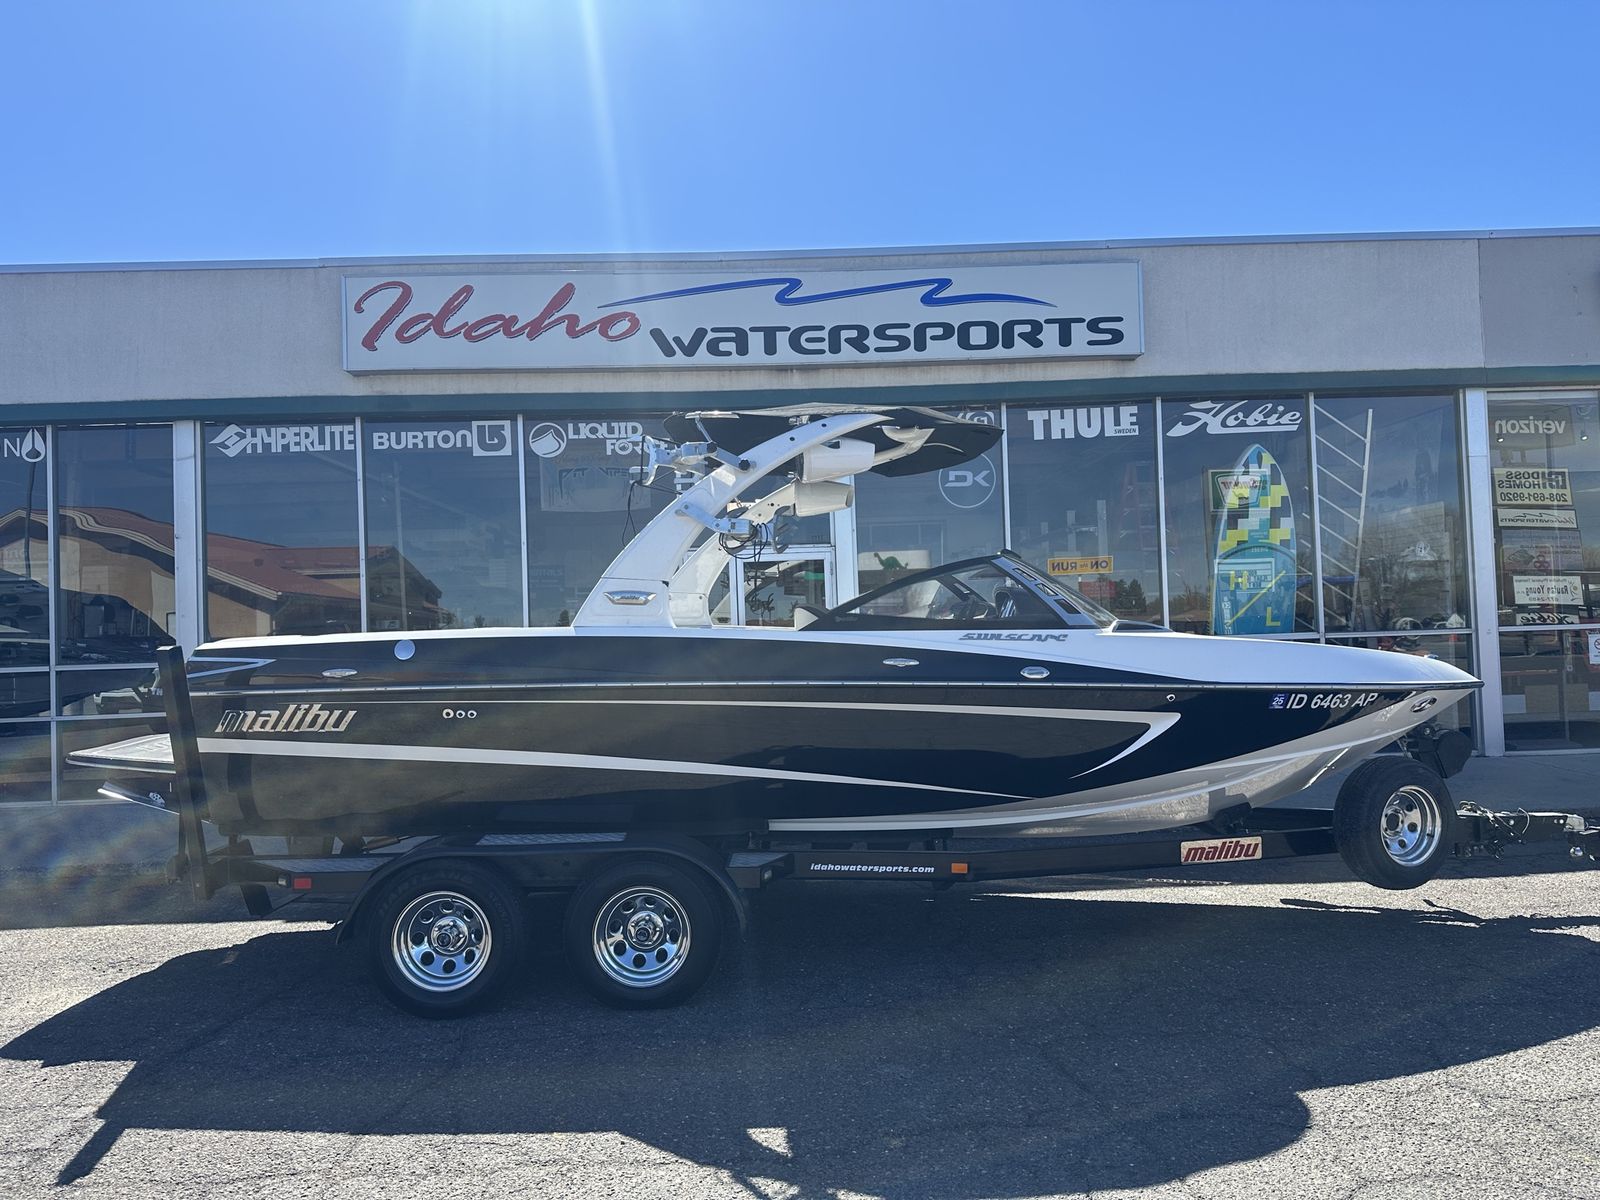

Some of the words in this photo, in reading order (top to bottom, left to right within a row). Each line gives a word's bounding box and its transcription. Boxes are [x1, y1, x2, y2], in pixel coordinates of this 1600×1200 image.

[353, 280, 641, 351] Idaho
[1027, 405, 1139, 440] THULE
[1166, 400, 1302, 437] Hobie
[246, 425, 355, 454] HYPERLITE
[567, 422, 643, 439] LIQUID
[943, 470, 991, 487] DK
[1272, 697, 1285, 705] 25
[1286, 693, 1308, 709] ID
[1310, 693, 1352, 709] 6463
[1351, 692, 1379, 708] AP
[215, 704, 357, 733] malibu
[1184, 840, 1260, 862] malibu
[810, 863, 935, 874] idahowatersports.com
